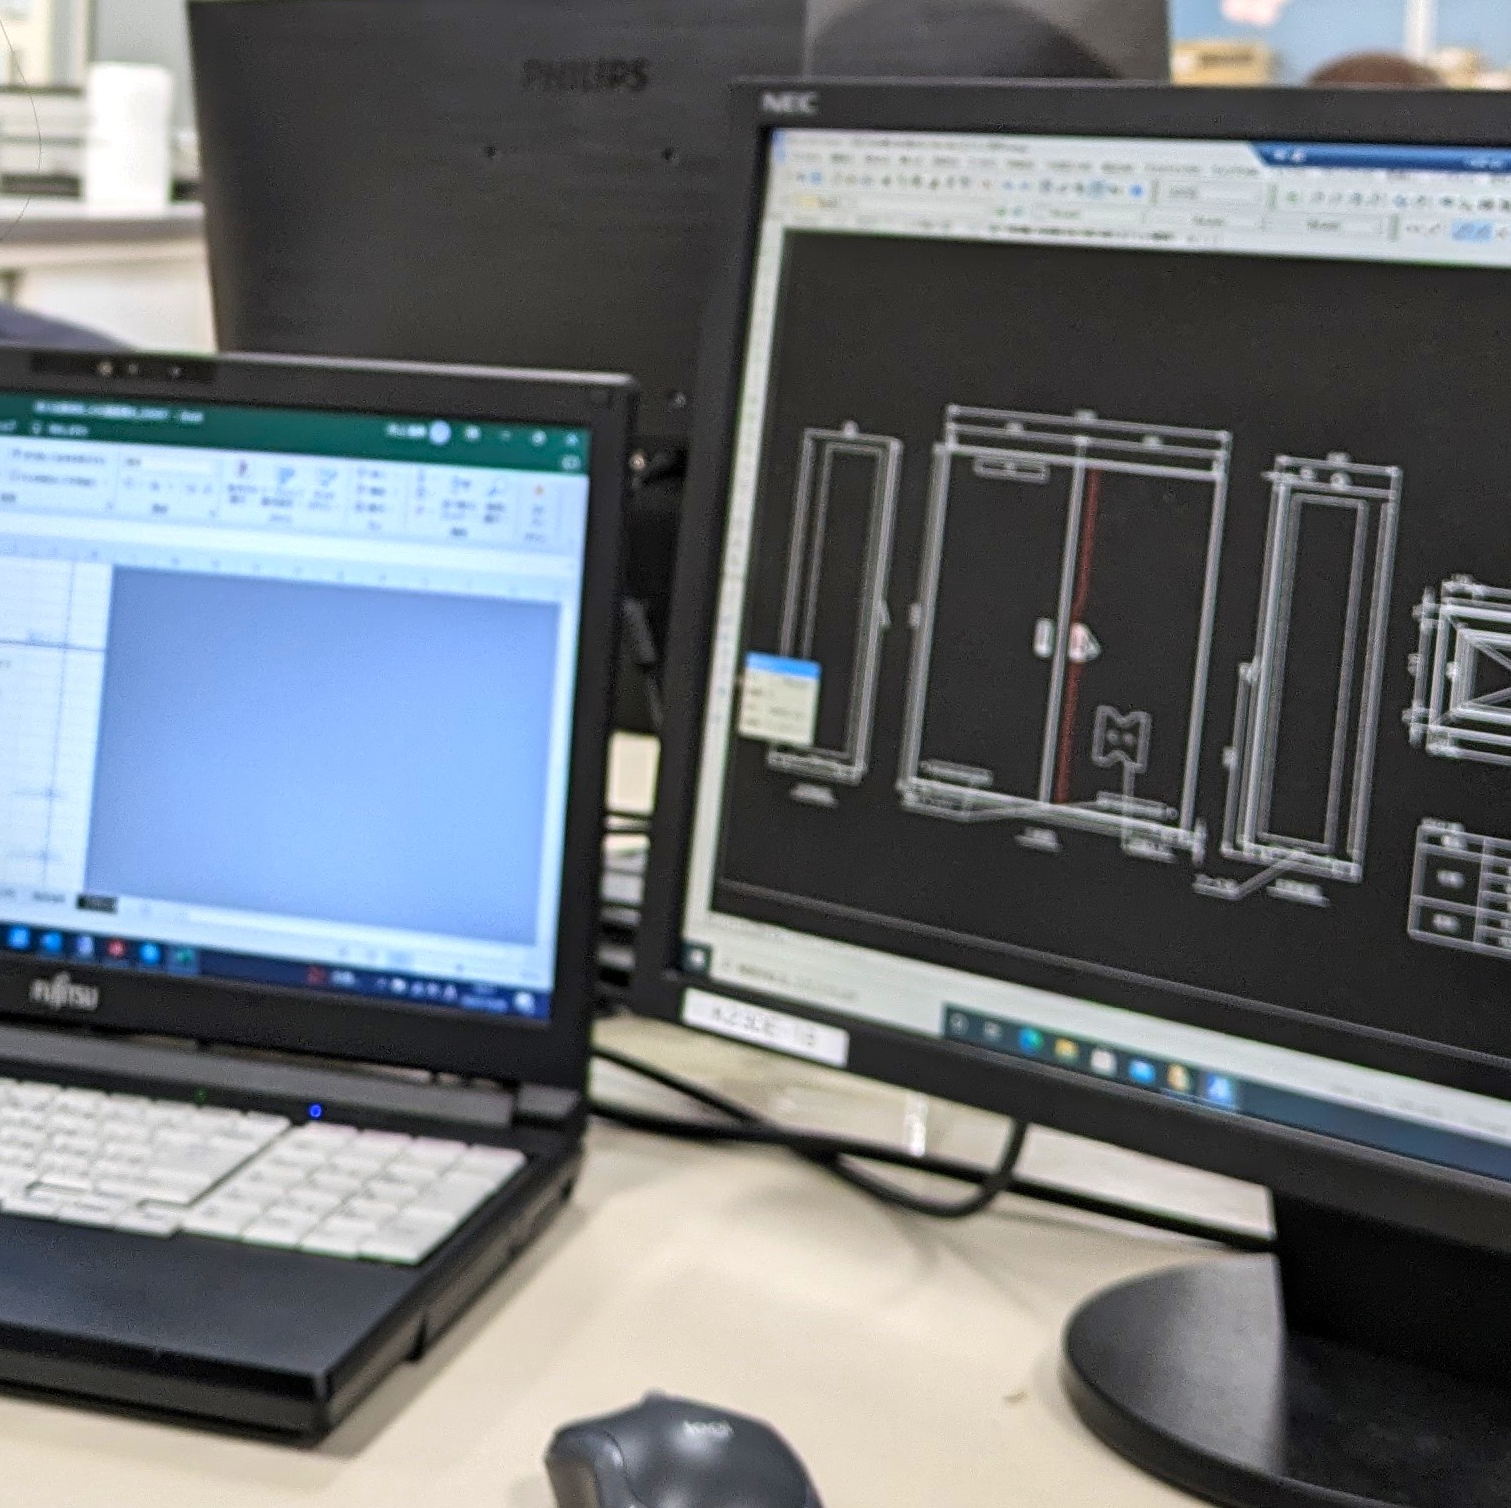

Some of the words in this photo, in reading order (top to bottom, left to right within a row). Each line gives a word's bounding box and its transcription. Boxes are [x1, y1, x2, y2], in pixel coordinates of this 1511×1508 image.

[522, 58, 650, 92] PHILIPS
[762, 92, 818, 114] NEC
[30, 971, 99, 1011] FUJITSU
